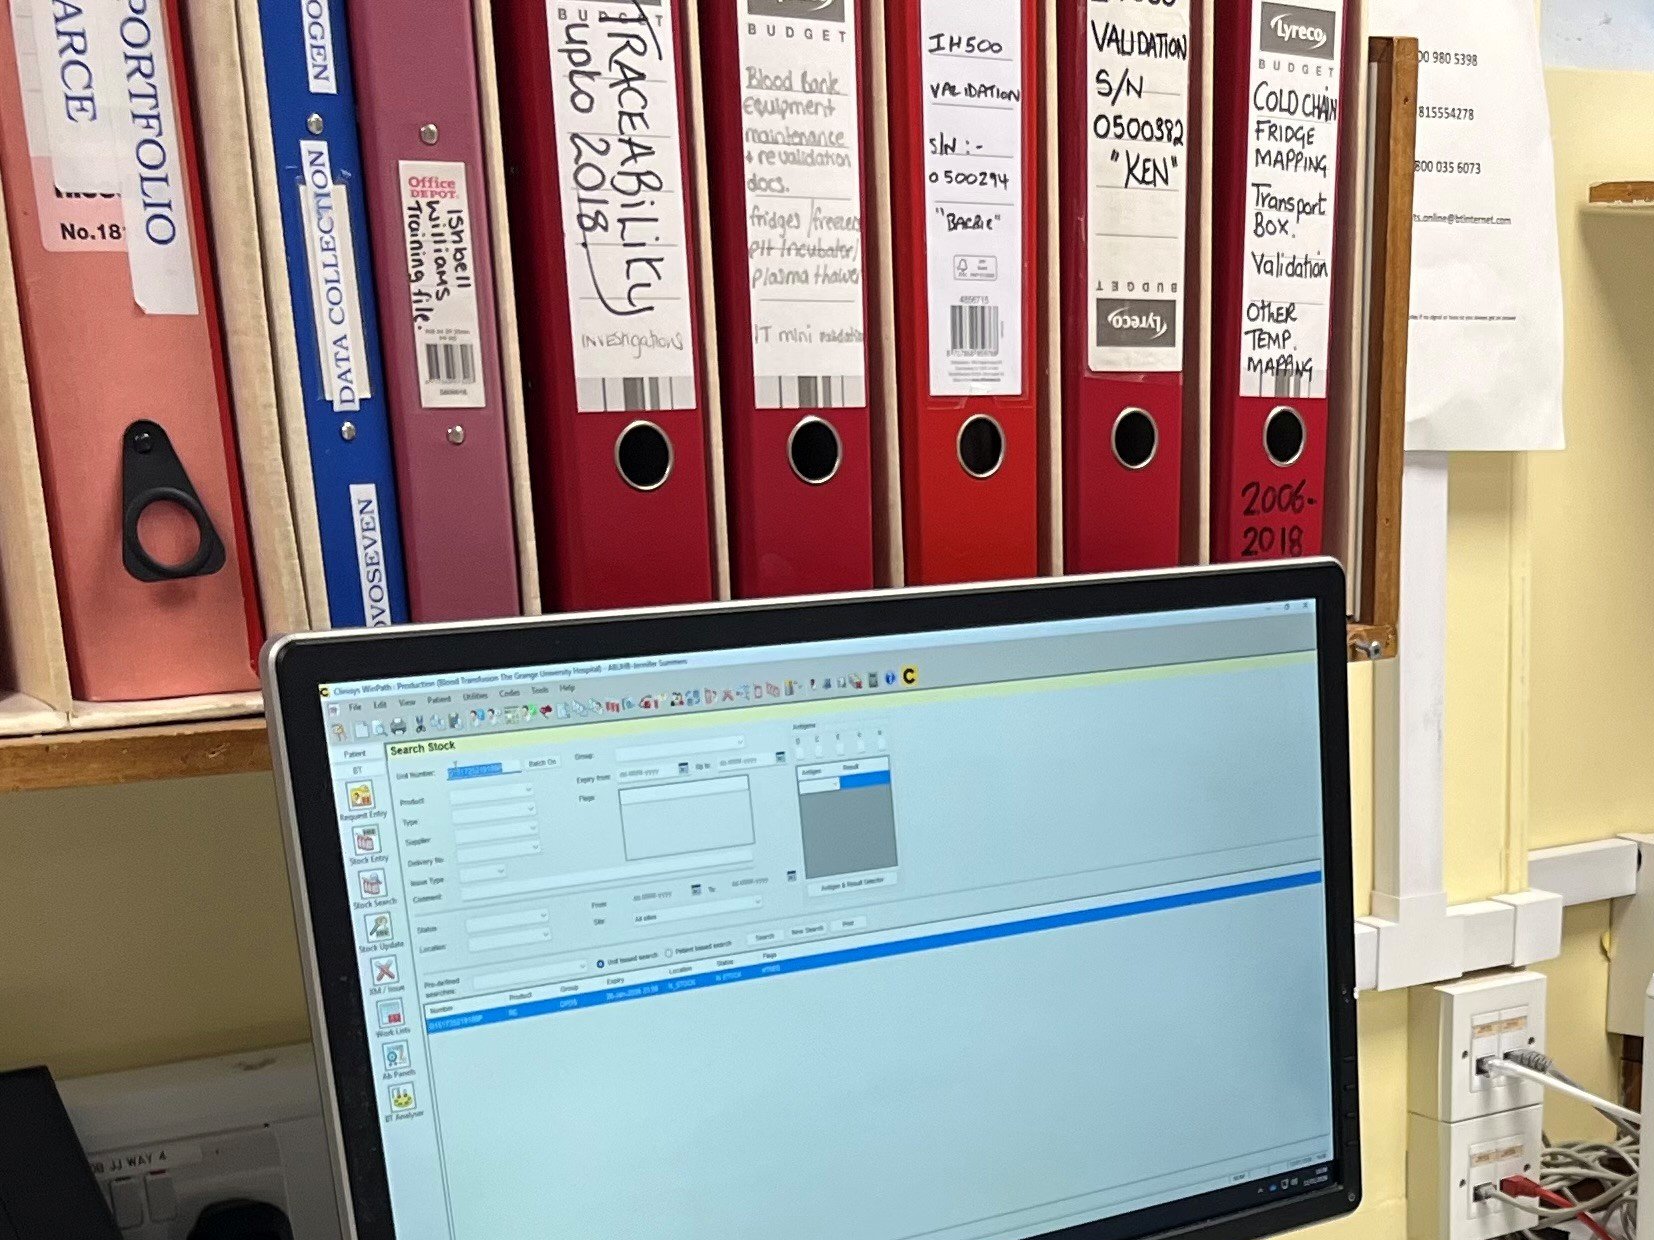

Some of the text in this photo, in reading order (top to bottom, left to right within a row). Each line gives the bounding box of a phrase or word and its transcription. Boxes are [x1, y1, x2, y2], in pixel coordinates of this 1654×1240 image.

[748, 23, 847, 43] BUDGET
[1276, 18, 1325, 42] Lyreco
[1258, 58, 1335, 78] BUDGET
[1095, 67, 1143, 107] S/N
[1255, 119, 1316, 149] FRIDGE
[1254, 148, 1327, 178] MAPPING
[408, 176, 456, 189] Office
[1251, 183, 1328, 224] Transport
[60, 223, 126, 240] No.18
[1251, 250, 1329, 279] Validation
[308, 150, 356, 406] DATA COLLECTION
[1096, 280, 1178, 293] BUDGET
[1112, 312, 1161, 333] Lyreco
[390, 740, 457, 757] Search Stock
[369, 810, 387, 819] Entry
